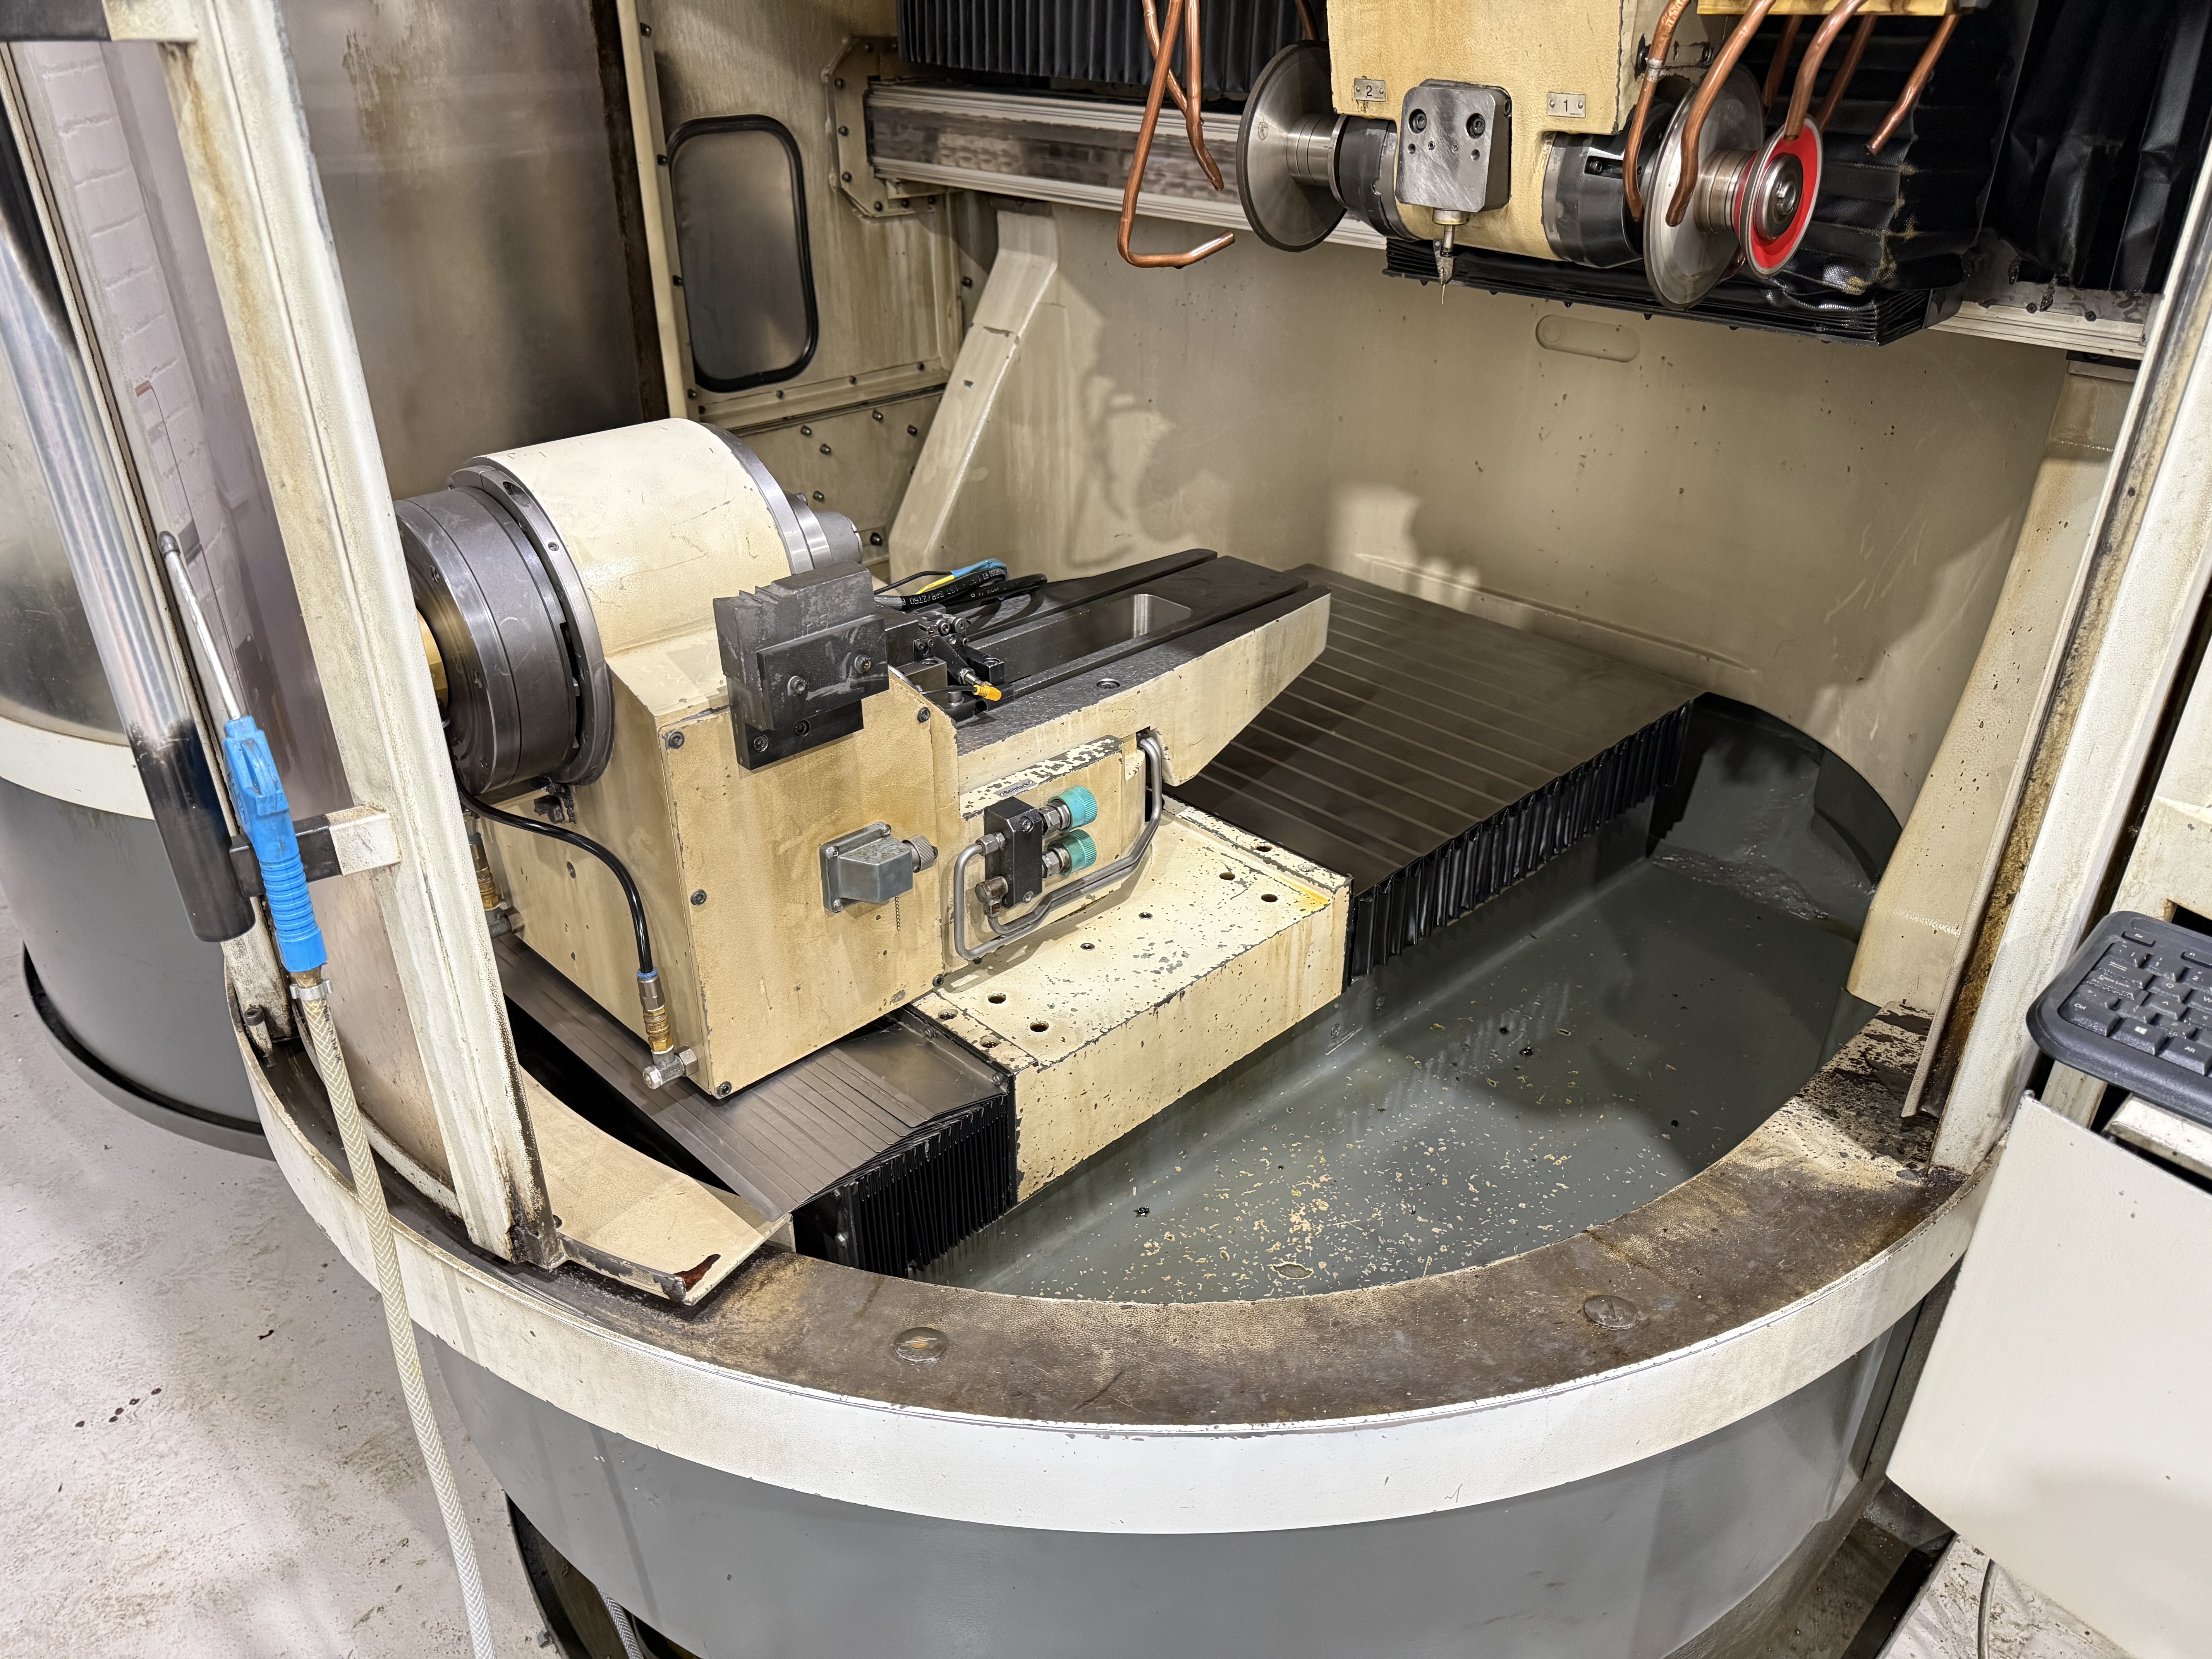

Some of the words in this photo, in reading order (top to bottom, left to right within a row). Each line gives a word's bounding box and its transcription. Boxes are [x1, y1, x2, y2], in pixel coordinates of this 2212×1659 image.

[1366, 85, 1372, 96] 2
[1563, 99, 1568, 112] 1
[335, 1053, 342, 1063] UK
